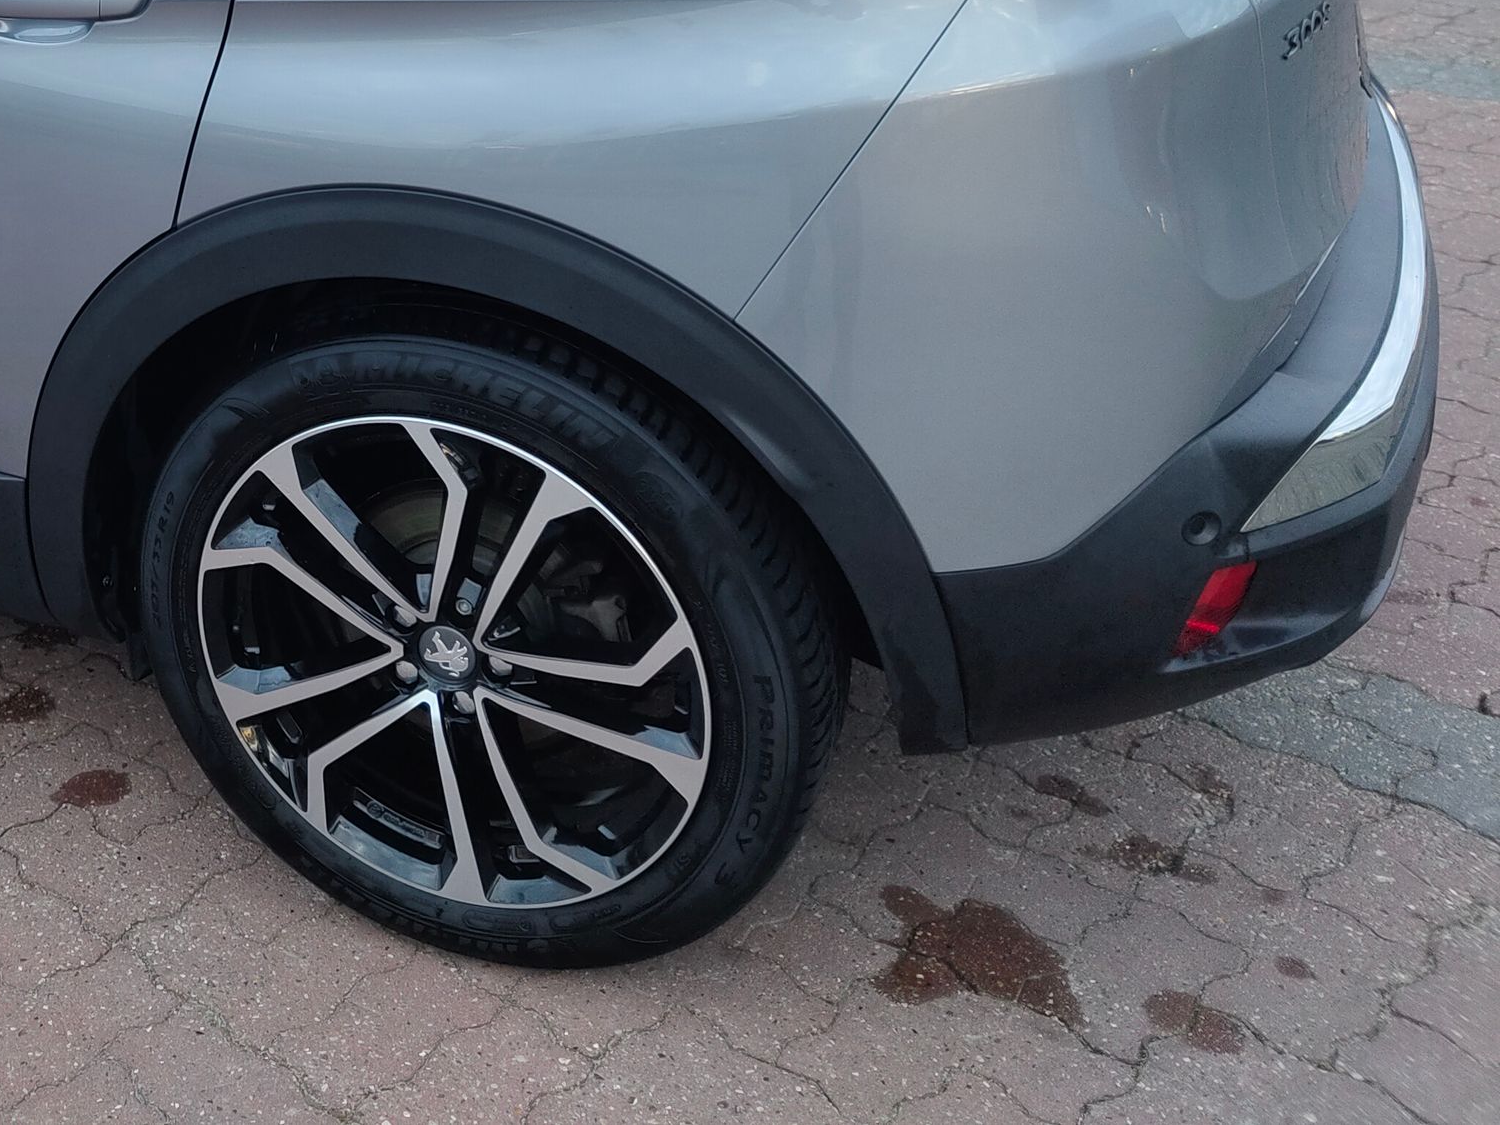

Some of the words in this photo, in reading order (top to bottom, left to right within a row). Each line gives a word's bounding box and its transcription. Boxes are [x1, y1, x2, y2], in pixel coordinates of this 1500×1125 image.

[351, 350, 618, 449] MICHELIN
[735, 674, 777, 854] PRIMACY
[714, 861, 738, 890] 3
